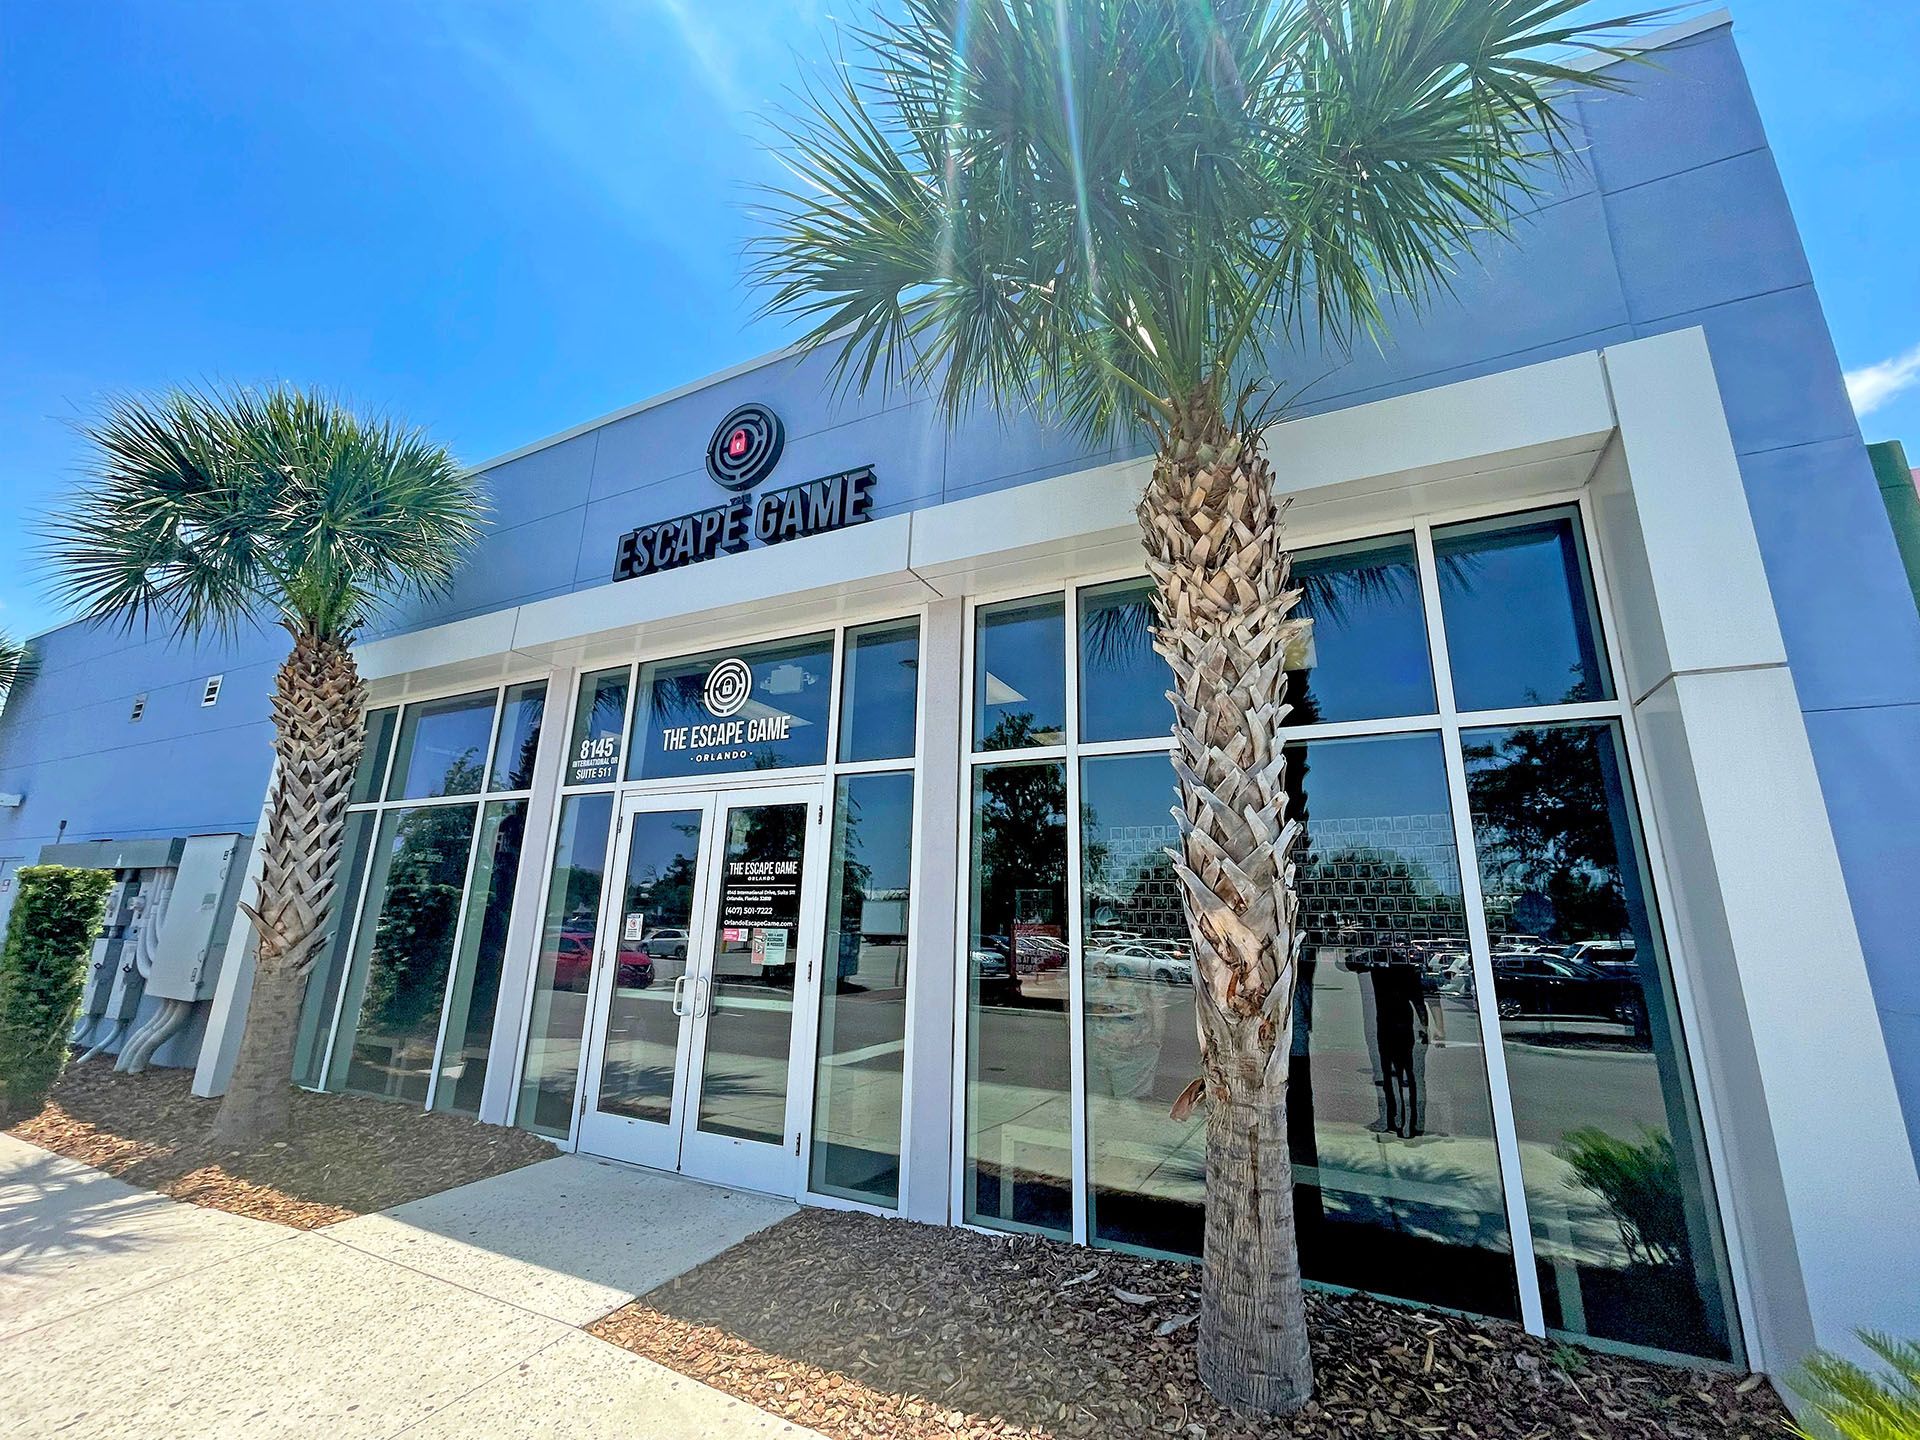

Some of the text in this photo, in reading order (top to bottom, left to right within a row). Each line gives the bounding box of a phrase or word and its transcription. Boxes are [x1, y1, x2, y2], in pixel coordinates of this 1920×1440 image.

[612, 469, 877, 582] ESCAPE GAME
[663, 715, 791, 751] THE ESCAPE GAME
[580, 737, 614, 760] 8145
[572, 757, 610, 768] INTERNATIONAL
[695, 749, 747, 763] ORLANDO
[575, 766, 612, 780] SUITE 511
[729, 861, 798, 875] THE ESCAPE GAME
[725, 906, 773, 916] (407) 501-7222
